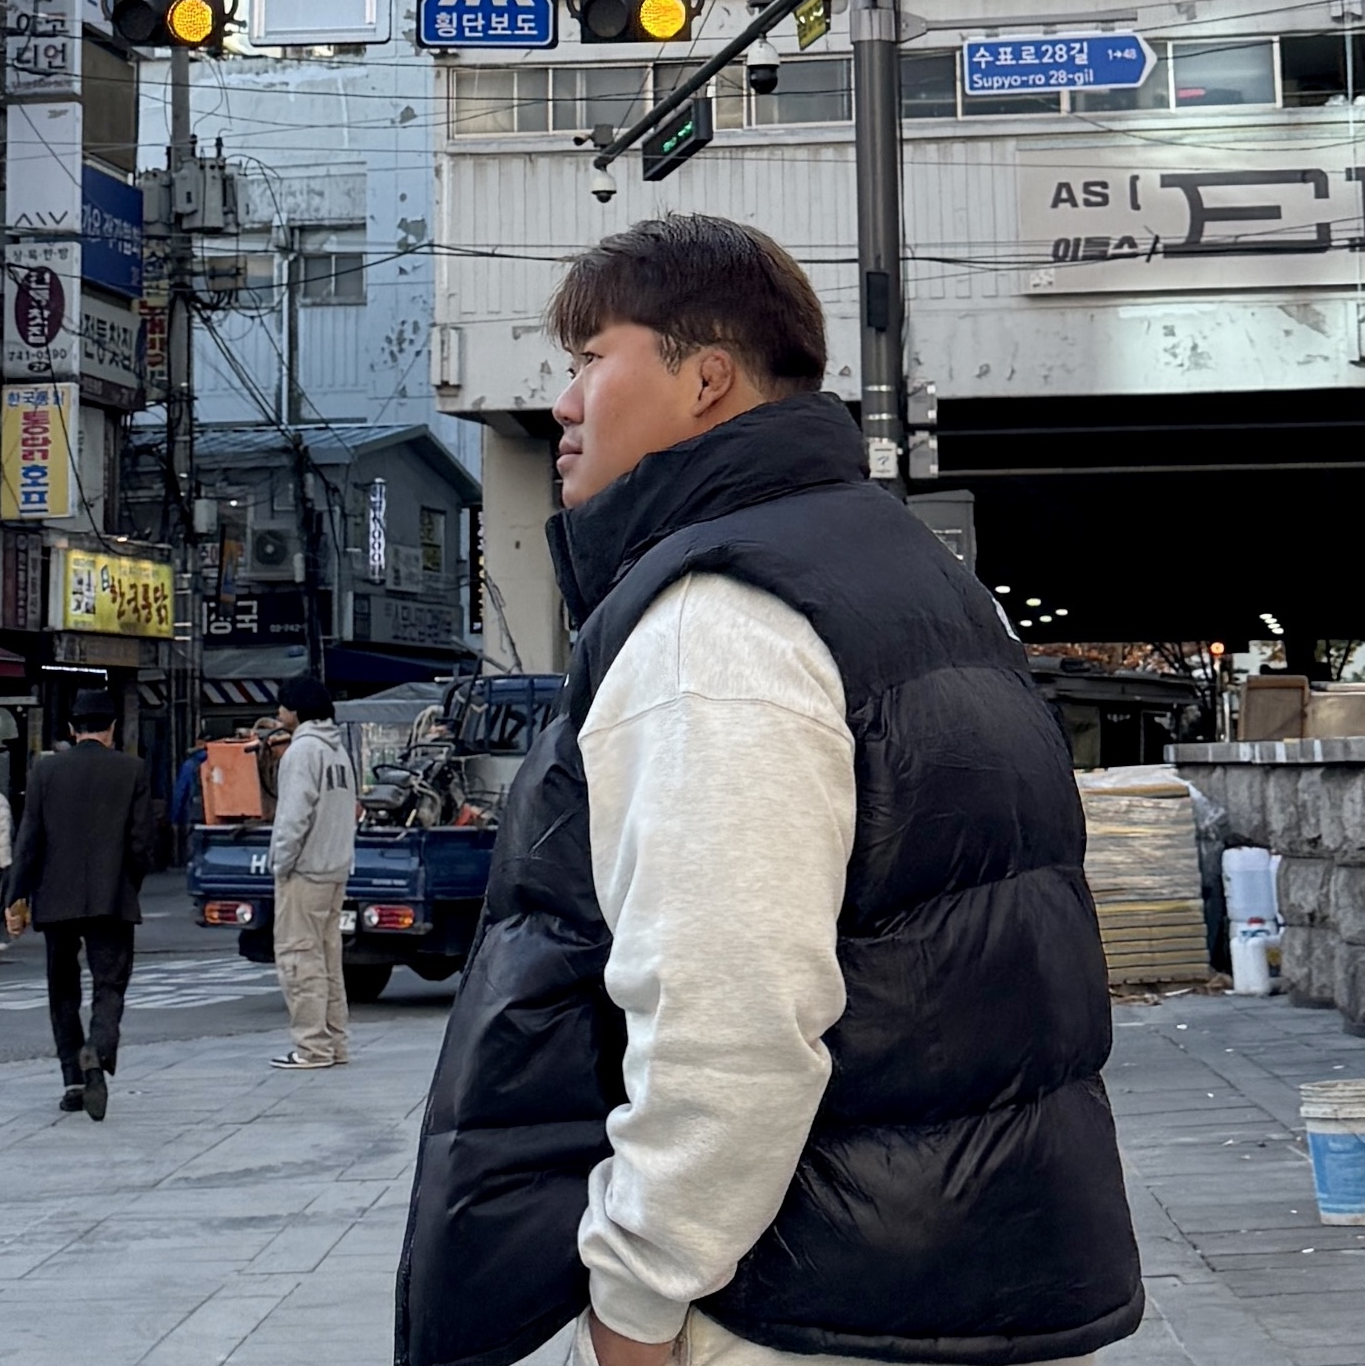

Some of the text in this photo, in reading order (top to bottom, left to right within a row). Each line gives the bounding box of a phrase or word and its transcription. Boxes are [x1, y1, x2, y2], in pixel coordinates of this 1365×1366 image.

[434, 13, 538, 36] 횡단보도
[972, 40, 1089, 67] 수표로28길
[973, 68, 1095, 89] Supyo-ro 28-gil
[1051, 181, 1110, 209] AS
